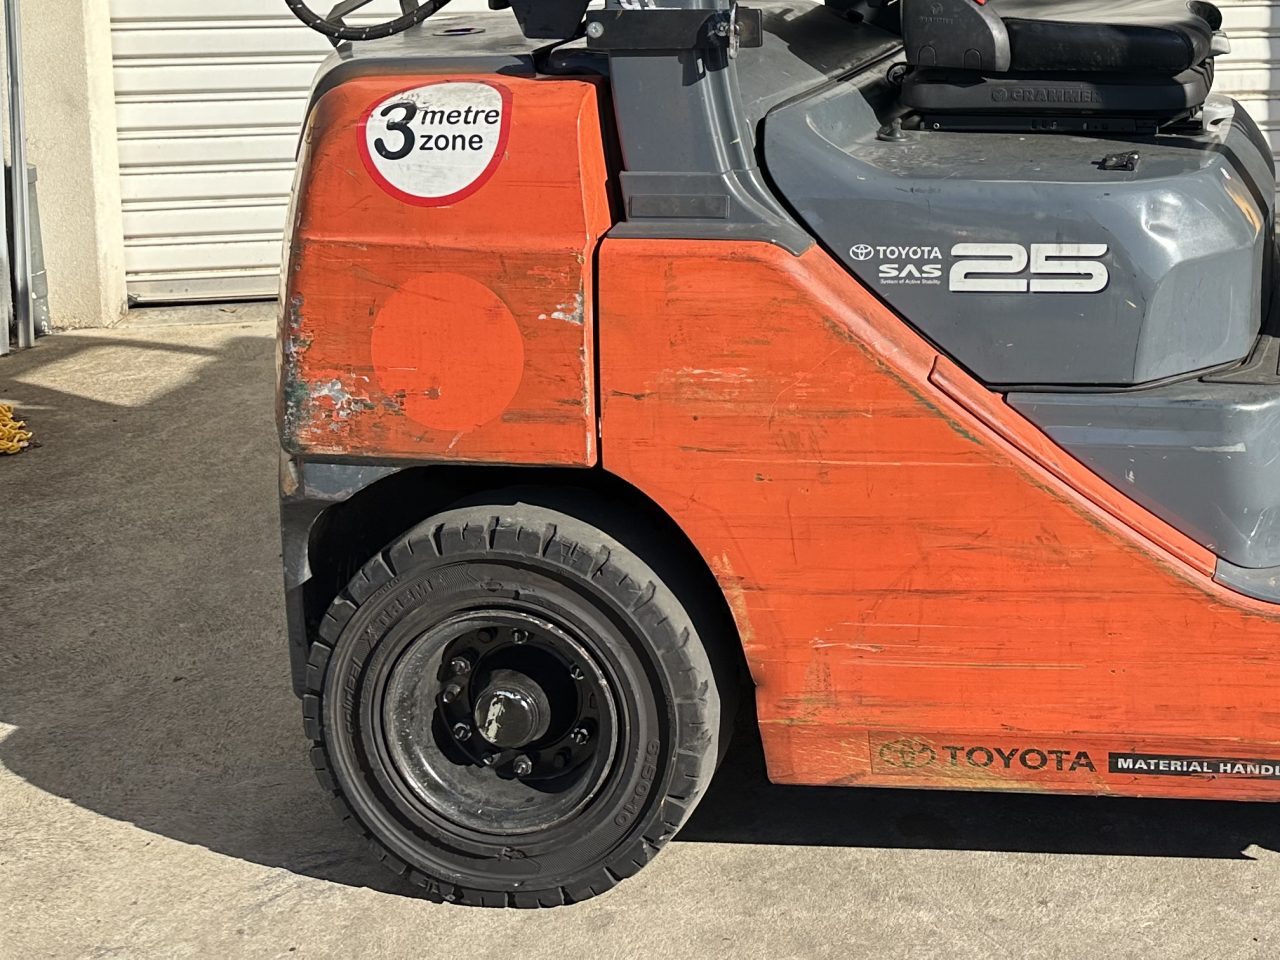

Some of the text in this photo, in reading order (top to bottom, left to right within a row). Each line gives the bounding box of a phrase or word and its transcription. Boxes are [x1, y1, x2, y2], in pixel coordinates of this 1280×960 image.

[373, 101, 500, 160] 3 metre
[419, 133, 483, 151] zone
[876, 246, 942, 259] TOYOTA
[879, 264, 942, 277] SAS
[949, 243, 1109, 292] 25
[943, 745, 1097, 773] TOYOTA
[1117, 757, 1213, 774] MATERIAL
